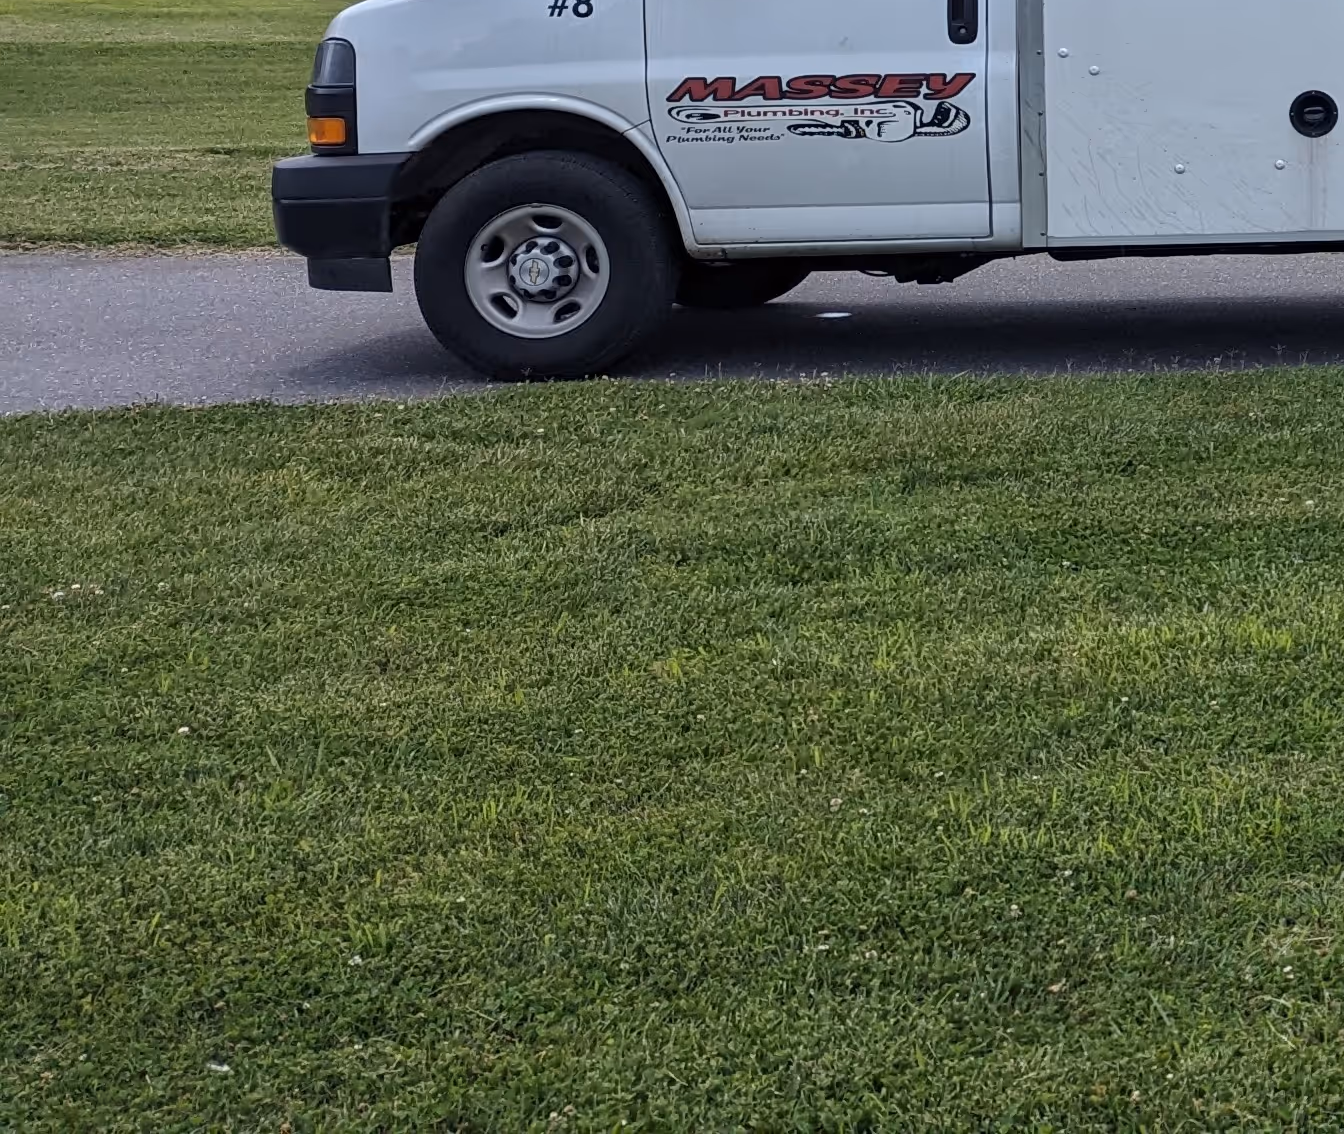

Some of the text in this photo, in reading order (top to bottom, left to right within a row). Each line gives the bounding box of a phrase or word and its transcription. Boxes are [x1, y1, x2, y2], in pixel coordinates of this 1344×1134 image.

[665, 73, 977, 103] MASSEY
[853, 107, 894, 117] Inc.
[712, 126, 734, 134] All
[736, 125, 771, 134] Your
[665, 133, 736, 143] Plumbing
